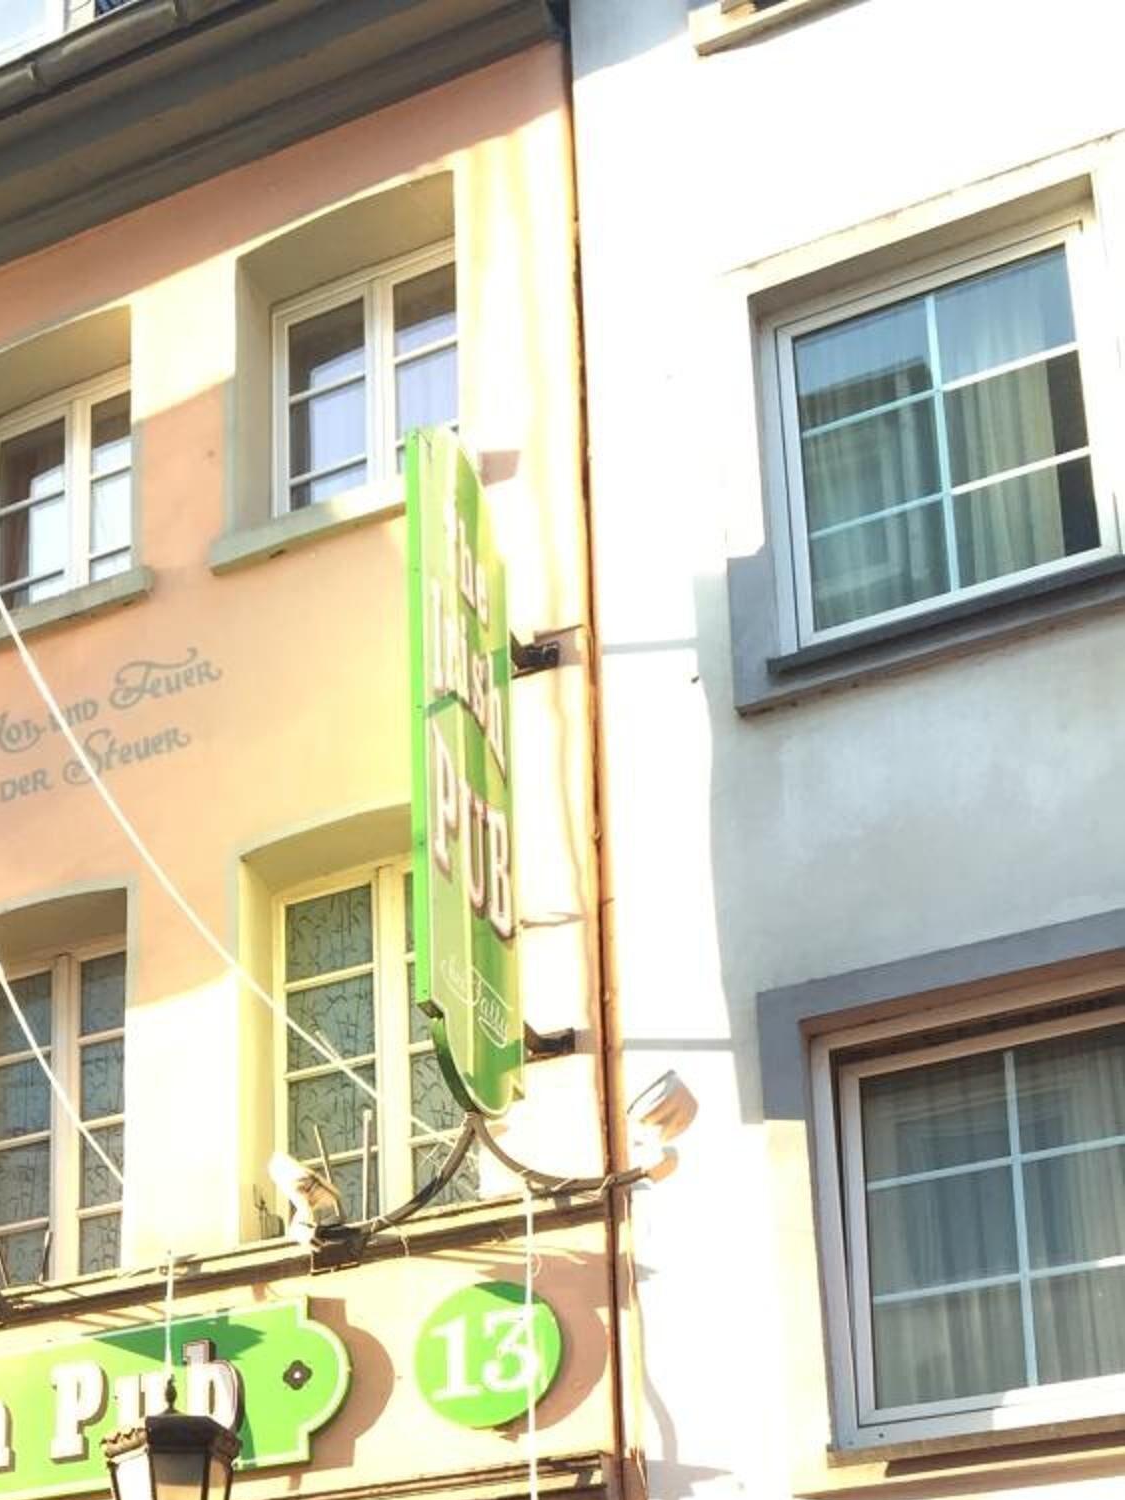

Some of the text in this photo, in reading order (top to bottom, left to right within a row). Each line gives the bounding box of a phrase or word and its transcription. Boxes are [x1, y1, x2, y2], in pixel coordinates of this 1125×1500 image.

[431, 716, 516, 940] PUB
[49, 1338, 243, 1463] Pub
[430, 1304, 539, 1400] 13
